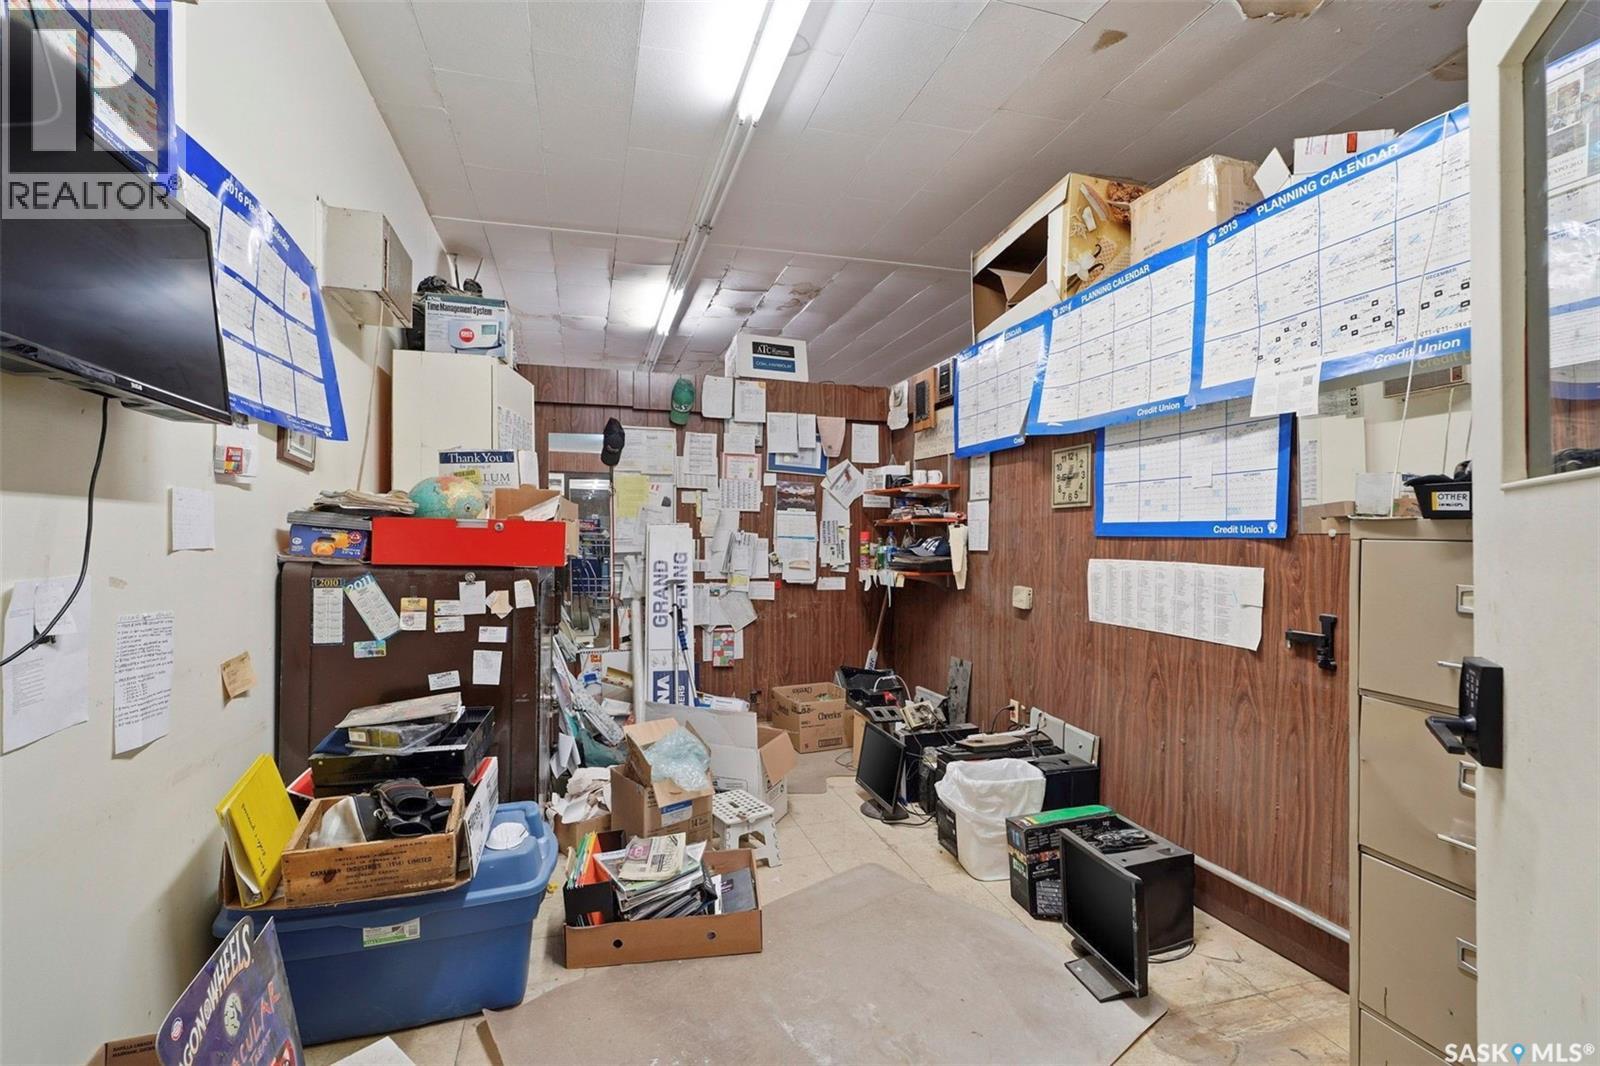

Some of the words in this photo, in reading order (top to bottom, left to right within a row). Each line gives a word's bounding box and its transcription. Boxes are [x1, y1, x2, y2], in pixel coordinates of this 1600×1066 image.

[1256, 181, 1317, 216] PLANNING
[1320, 144, 1399, 186] CALENDAR
[224, 178, 243, 203] 2016
[1218, 219, 1239, 238] 2013
[1426, 267, 1457, 281] DECEMBER
[1081, 280, 1112, 304] PLANNING
[1112, 264, 1151, 289] CALENDAR
[427, 302, 439, 311] Time
[440, 303, 473, 314] Management
[473, 306, 492, 316] System
[757, 344, 772, 354] ATC
[1373, 349, 1414, 365] Credit
[1418, 337, 1462, 355] Union
[1137, 405, 1158, 417] Credit
[1159, 402, 1181, 415] Union
[447, 452, 480, 464] Thank
[482, 452, 503, 463] You
[1061, 455, 1067, 463] 11
[1068, 452, 1074, 461] 12
[1056, 463, 1062, 471] 10
[1079, 460, 1084, 468] 2
[1081, 470, 1085, 479] 3
[1079, 482, 1083, 490] 4
[1062, 492, 1066, 500] 7
[1068, 492, 1072, 501] 6
[1074, 490, 1079, 499] 5
[1438, 493, 1468, 501] OTHER
[1213, 524, 1238, 534] Credit
[318, 578, 340, 588] 2010
[347, 575, 372, 592] 2011
[653, 560, 669, 628] GRAND
[818, 711, 842, 721] Cheerios
[310, 868, 342, 878] CANAAN
[407, 856, 433, 866] LIMITED
